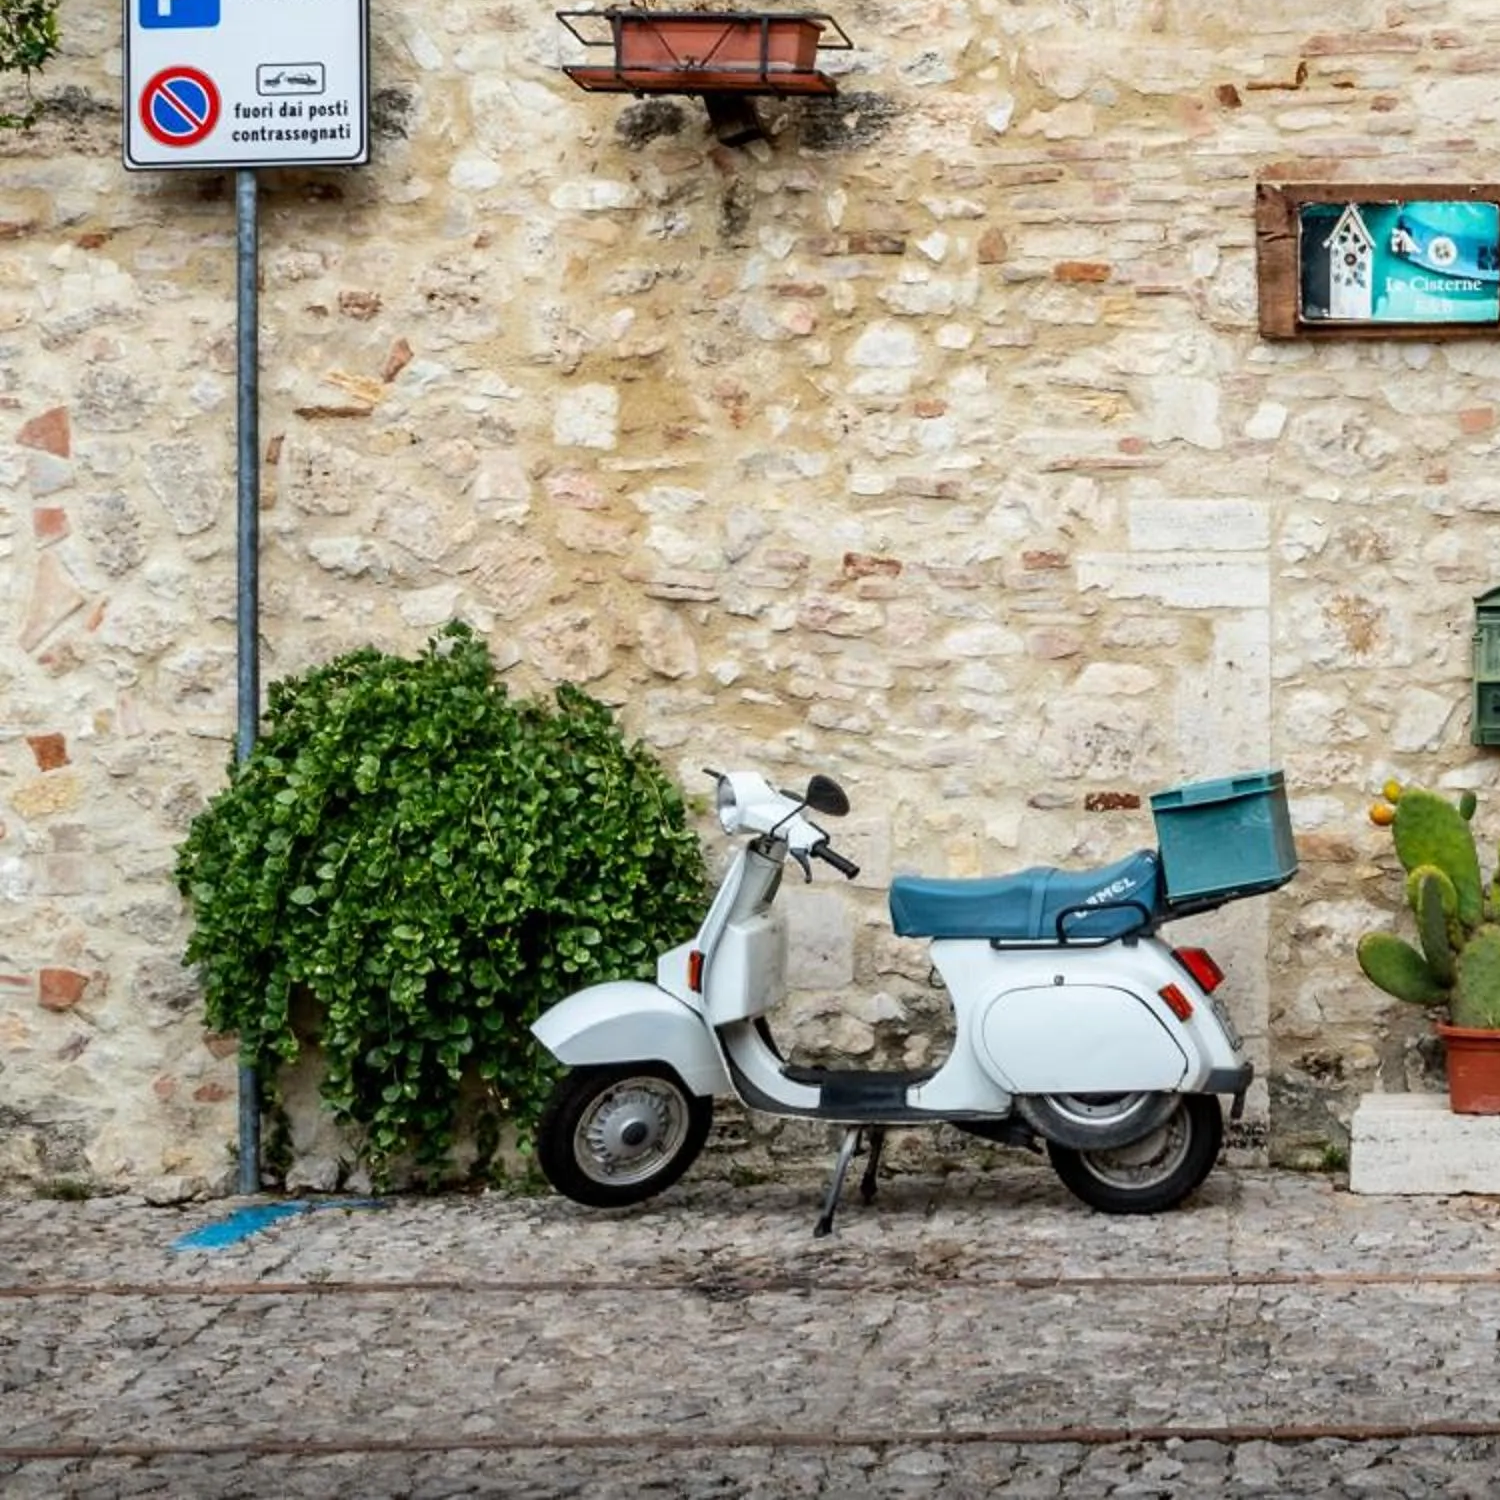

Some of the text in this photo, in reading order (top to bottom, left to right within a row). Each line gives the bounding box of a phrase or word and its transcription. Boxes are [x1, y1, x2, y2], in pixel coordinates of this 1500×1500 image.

[234, 99, 349, 122] fuori dai posti
[231, 123, 351, 145] contrassegnati
[1384, 276, 1483, 293] Le Cisterne
